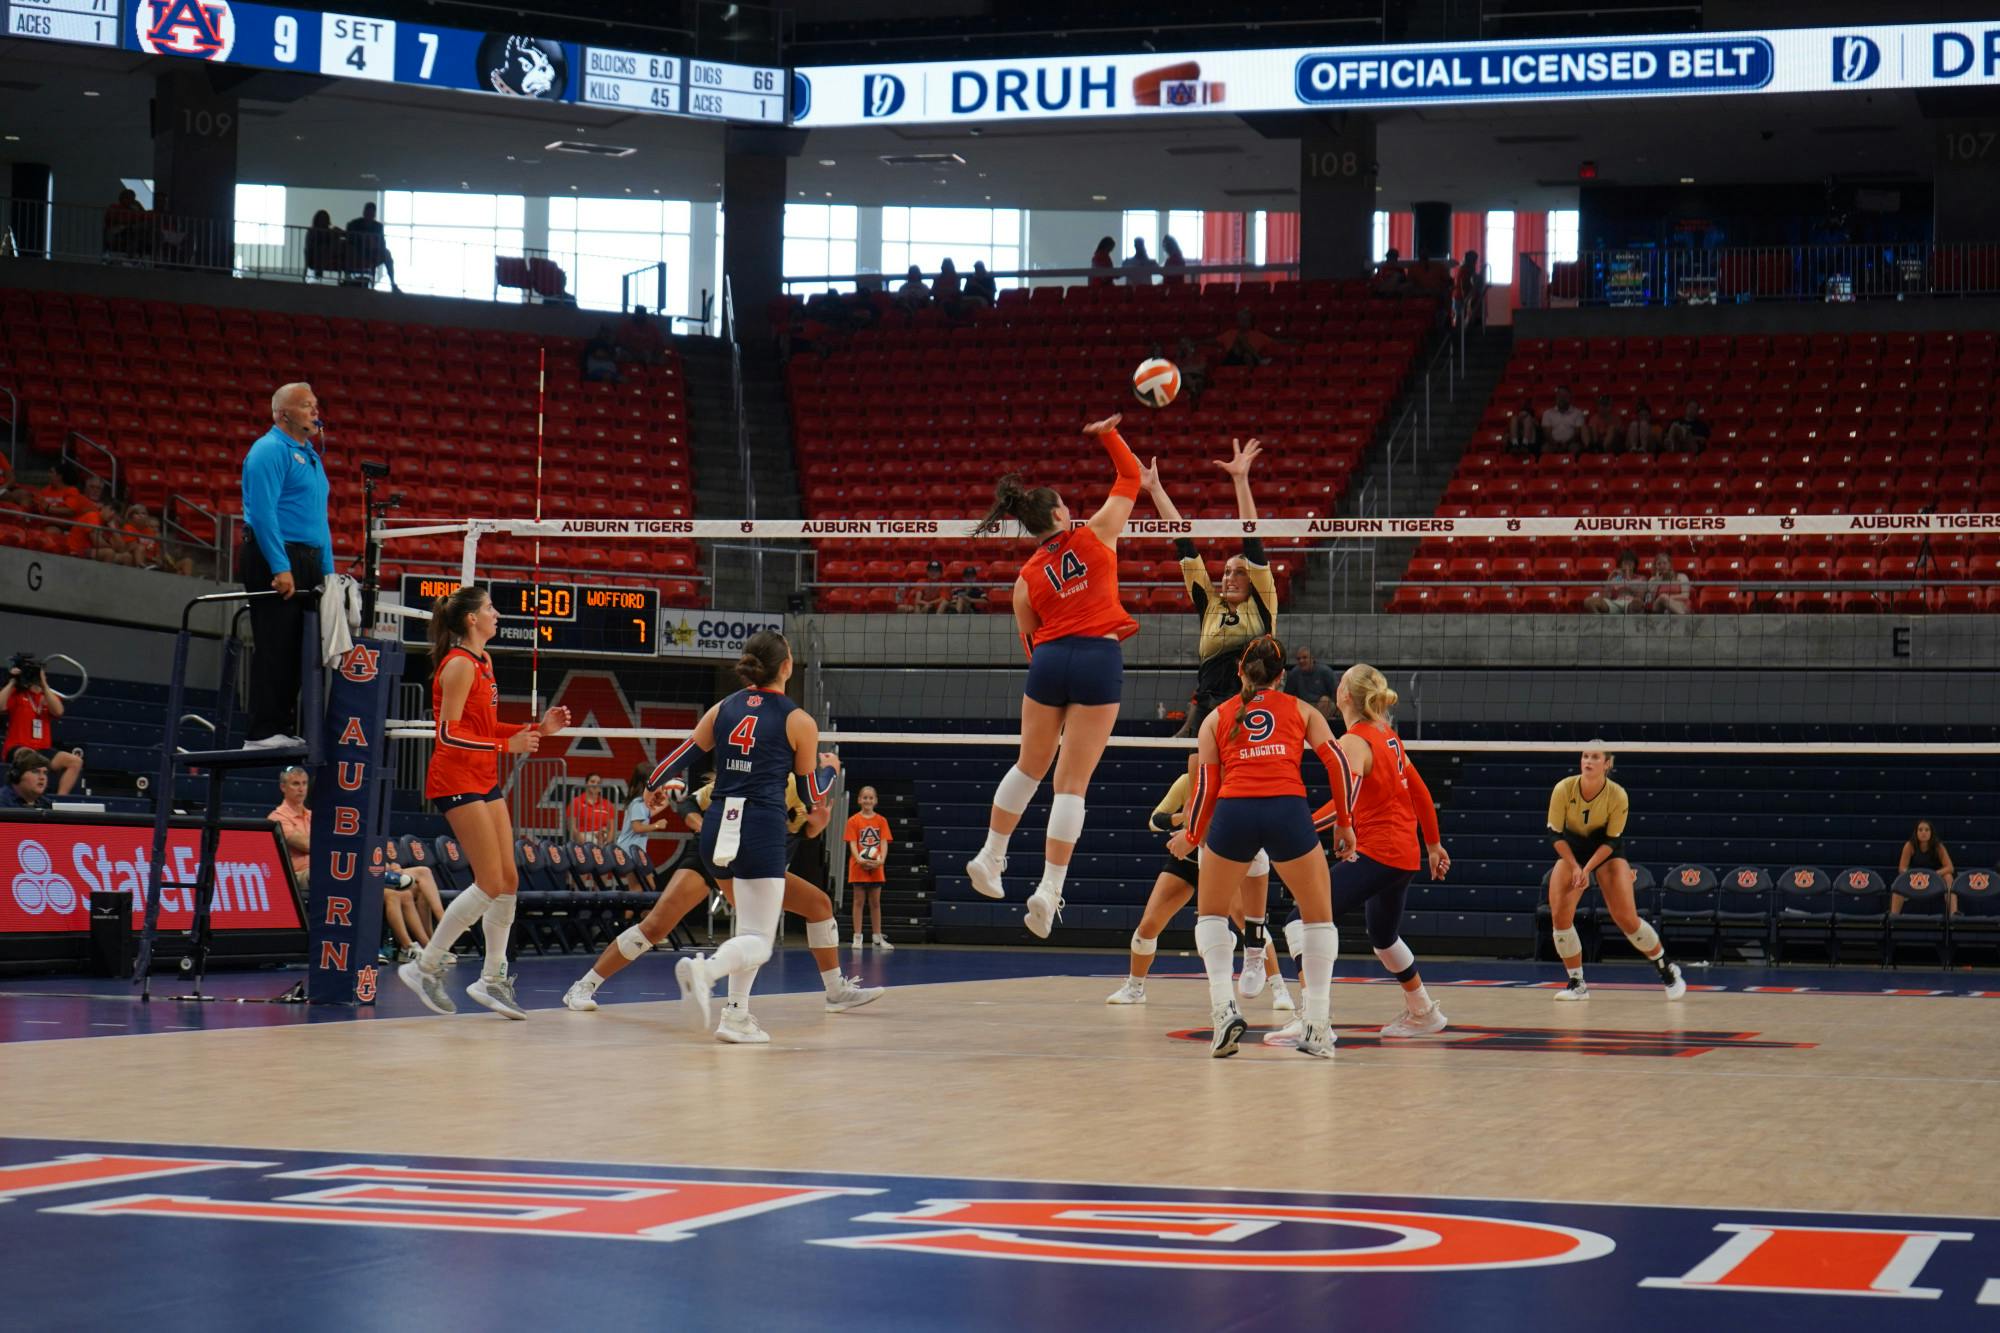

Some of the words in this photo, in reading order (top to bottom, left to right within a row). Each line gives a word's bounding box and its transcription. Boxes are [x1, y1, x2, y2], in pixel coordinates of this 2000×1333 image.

[17, 14, 51, 35] ACES
[94, 20, 101, 41] 1
[273, 15, 298, 63] 9
[334, 19, 384, 42] SET
[345, 45, 367, 71] 4
[418, 32, 439, 79] 7
[590, 53, 636, 75] BLOCKS
[649, 58, 673, 80] 6.0
[1310, 57, 1472, 91] OFFICIAL
[1480, 49, 1657, 85] LICENSED
[1668, 46, 1755, 79] BELT
[694, 65, 722, 85] DIGS
[753, 71, 774, 91] 66
[951, 65, 1117, 114] DRUH
[589, 82, 620, 102] KILLS
[651, 87, 670, 108] 45
[693, 96, 722, 114] ACES
[759, 99, 766, 118] 1
[183, 109, 232, 137] 109
[1308, 152, 1357, 176] 108
[561, 521, 629, 533] AUBURN
[634, 521, 694, 533] TIGERS
[801, 521, 872, 533] AUBURN
[877, 521, 938, 533] TIGERS
[1127, 521, 1192, 533] TIGERS
[1308, 520, 1382, 532] AUBURN
[1388, 520, 1454, 532] TIGERS
[1574, 518, 1652, 530] AUBURN
[1658, 518, 1726, 530] TIGERS
[1850, 517, 1930, 528] AUBURN
[27, 561, 43, 591] G
[1043, 549, 1088, 592] 14
[522, 590, 570, 617] 1:30
[587, 591, 645, 609] WOFFORD
[500, 628, 535, 640] PERIOD
[541, 626, 552, 642] 4
[633, 618, 645, 643] 7
[1892, 627, 1910, 657] E
[698, 639, 724, 649] PEST
[728, 715, 759, 755] 4
[1242, 708, 1276, 742] 9
[1239, 744, 1287, 760] SLAUGHTER
[726, 758, 753, 773] LANHAM
[1582, 809, 1590, 825] 1
[319, 717, 369, 971] AUBURN
